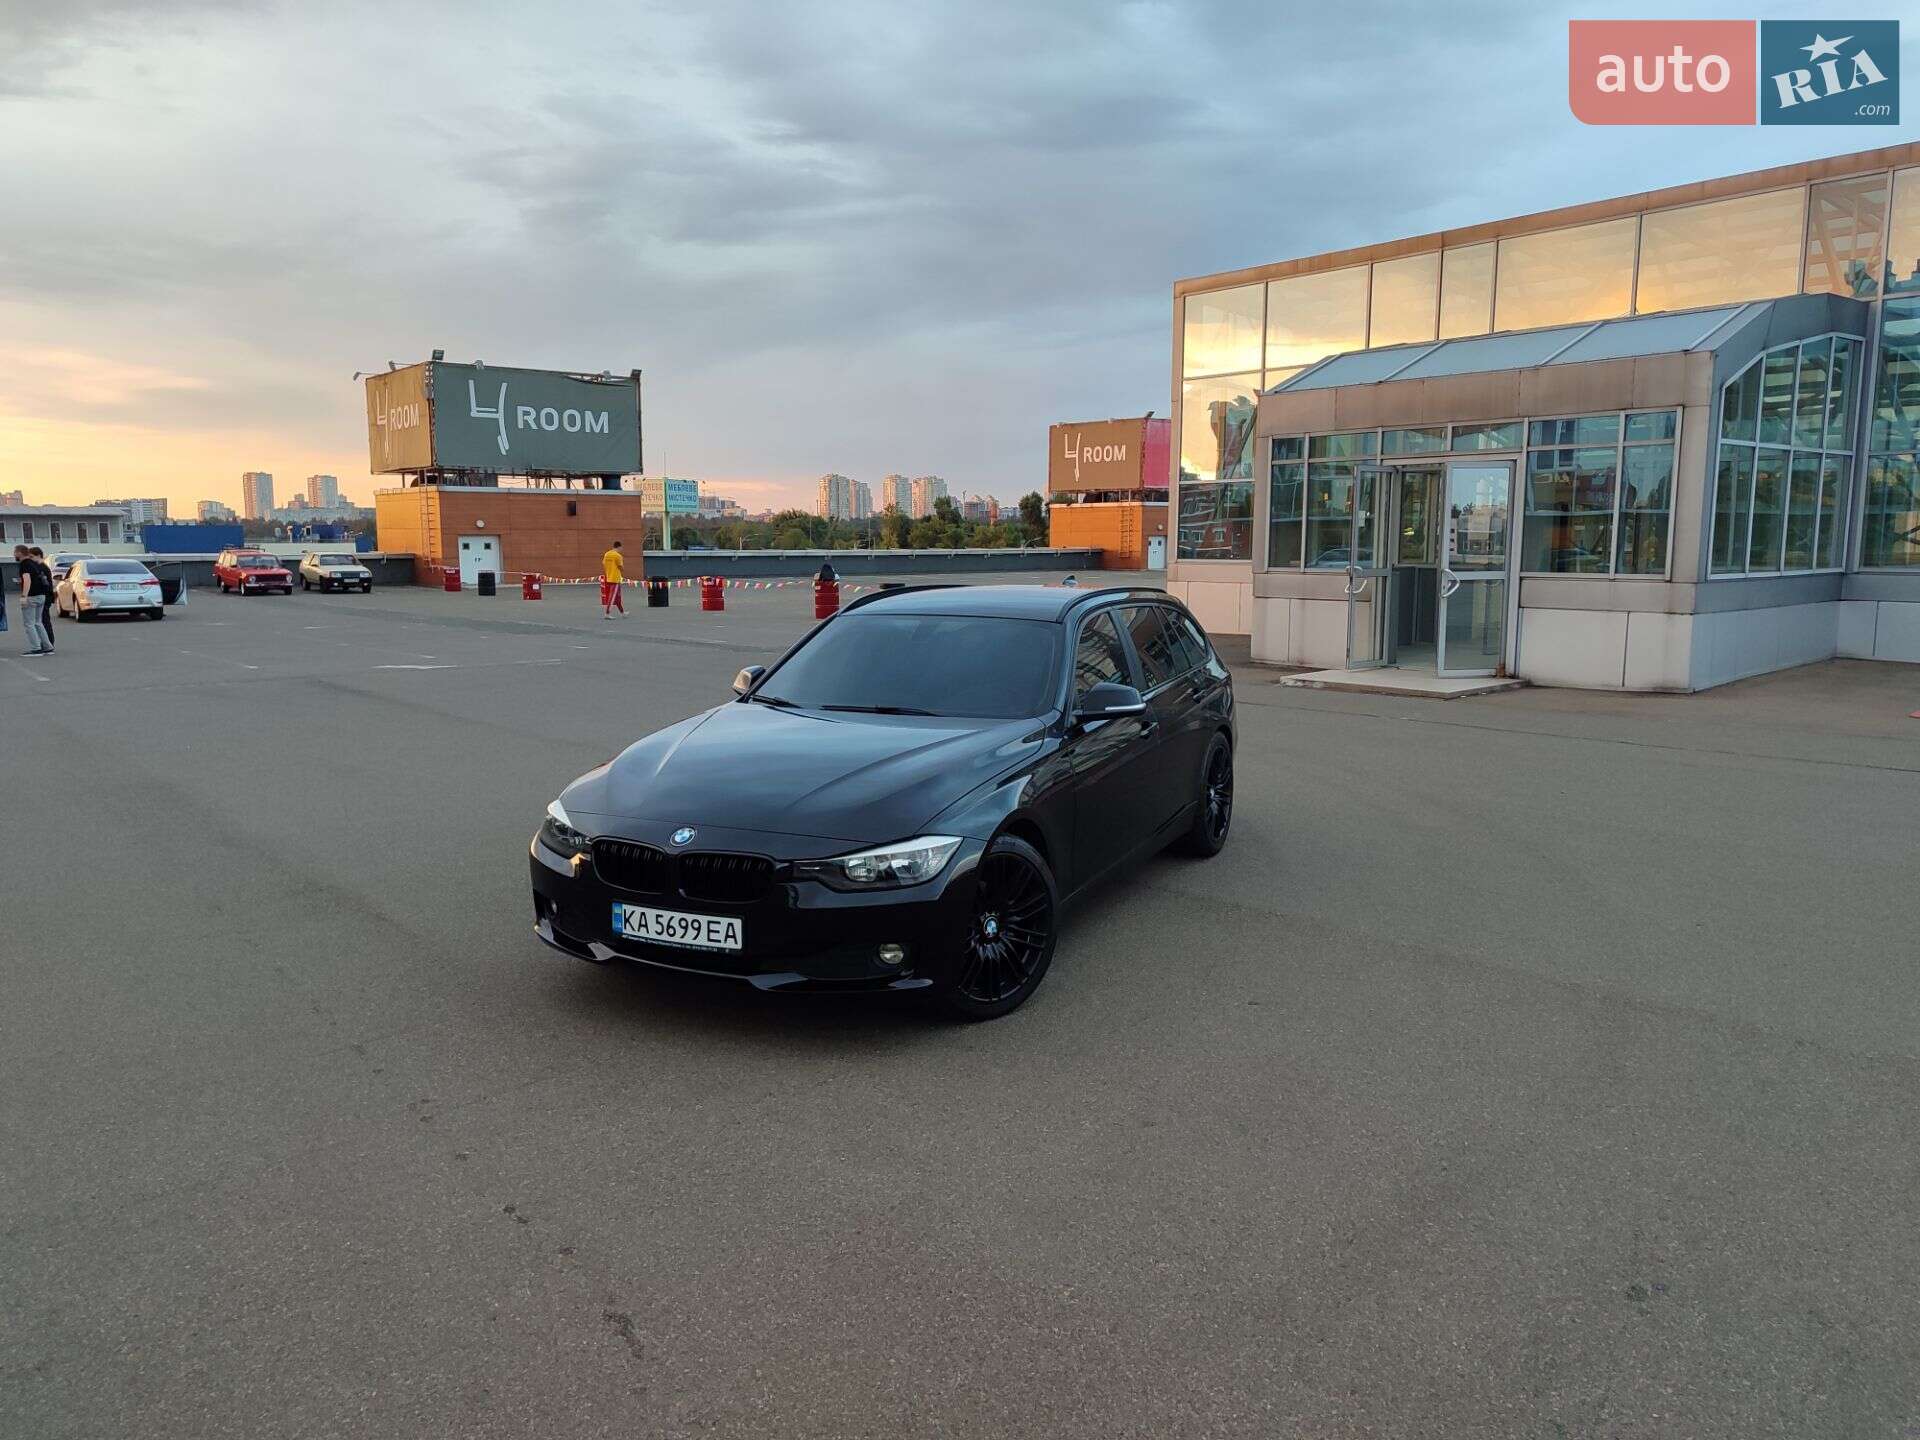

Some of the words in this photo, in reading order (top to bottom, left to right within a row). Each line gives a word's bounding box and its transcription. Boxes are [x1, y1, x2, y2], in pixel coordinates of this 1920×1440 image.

[390, 403, 420, 431] ROOM
[516, 405, 610, 434] ROOM
[1083, 444, 1127, 464] ROOM
[623, 908, 650, 934] KA
[655, 914, 702, 940] 5699
[706, 919, 739, 945] EA
